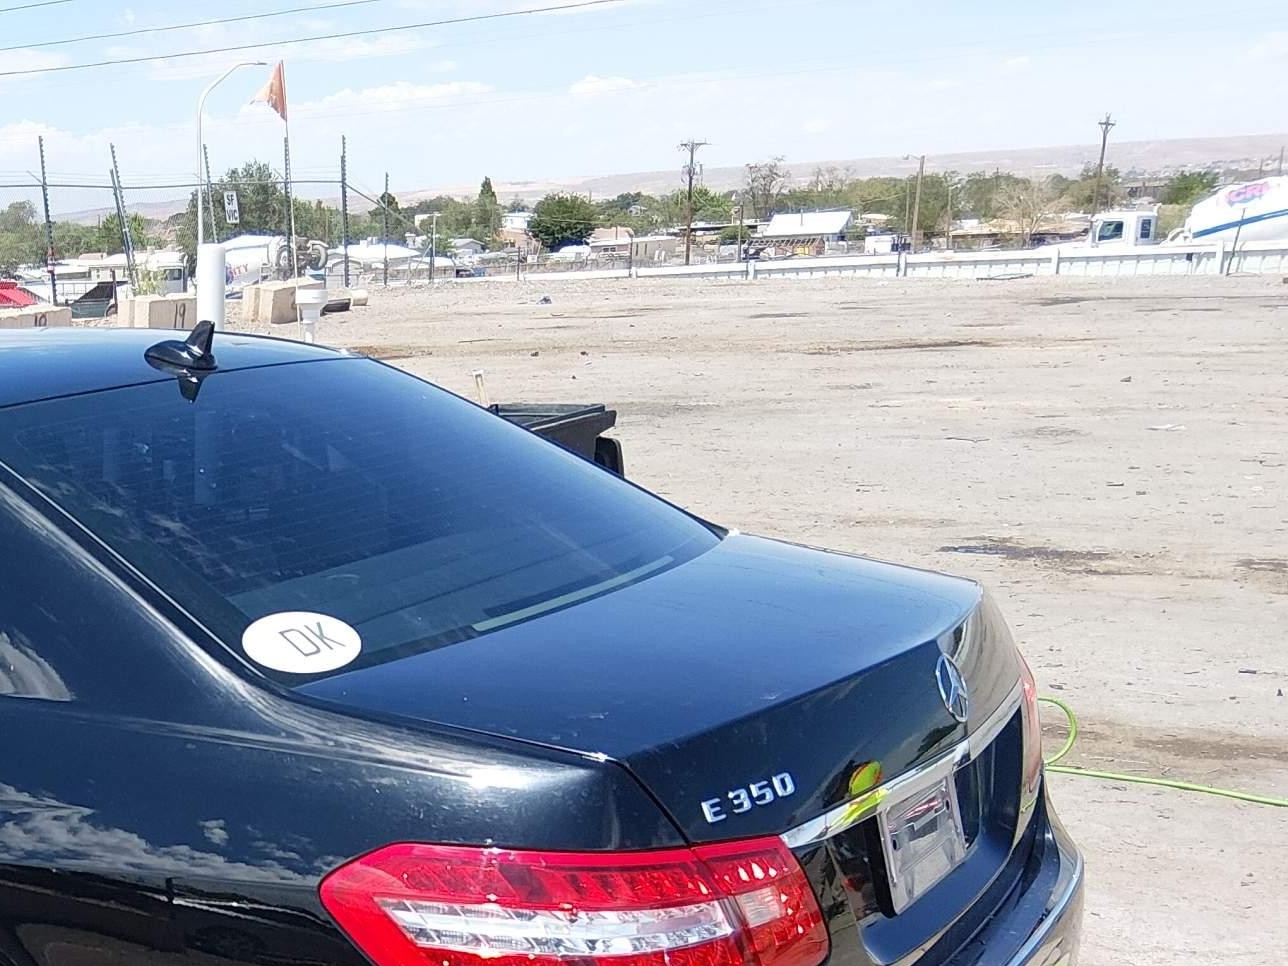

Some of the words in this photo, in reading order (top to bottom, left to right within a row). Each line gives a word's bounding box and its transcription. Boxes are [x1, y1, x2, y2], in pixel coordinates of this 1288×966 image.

[226, 193, 235, 206] SF
[227, 208, 238, 221] VIC
[173, 302, 187, 329] 19
[278, 621, 347, 657] DK
